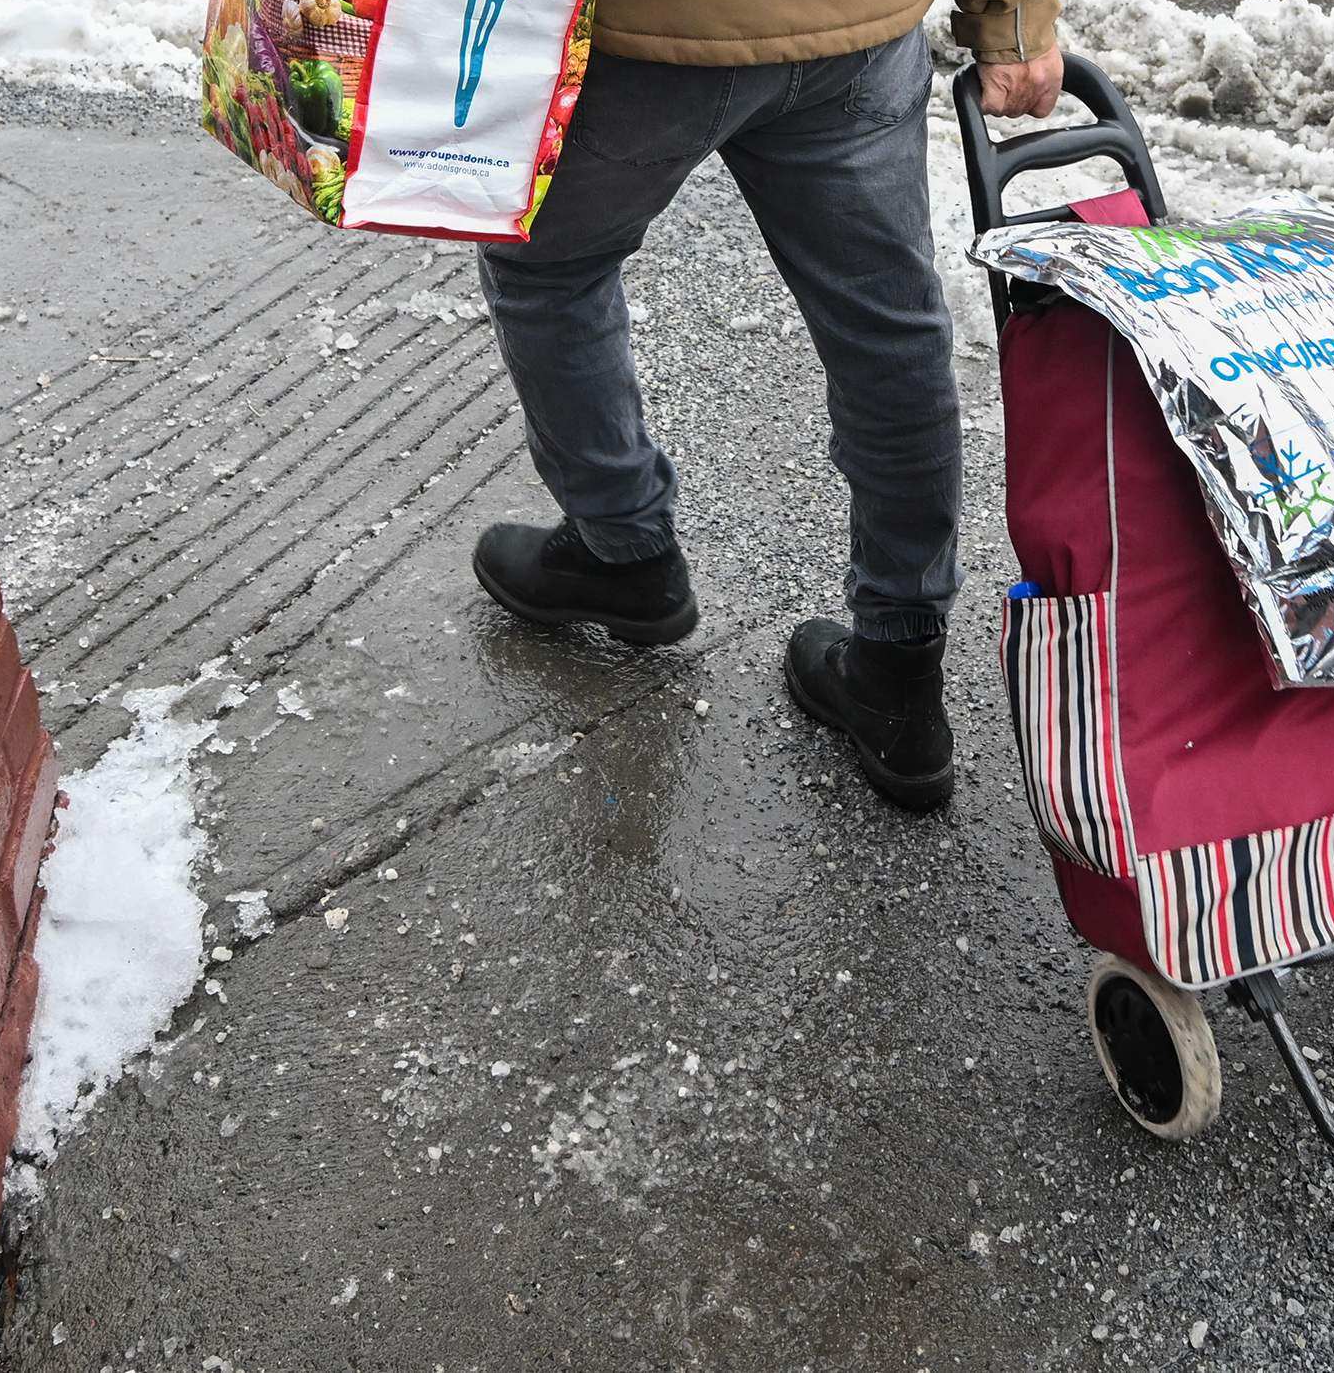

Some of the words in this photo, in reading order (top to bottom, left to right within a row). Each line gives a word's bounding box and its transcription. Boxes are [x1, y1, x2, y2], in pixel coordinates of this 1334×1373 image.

[388, 147, 510, 168] www.groupeadonis.ca
[403, 160, 490, 178] www.adonisgroup.ca
[1105, 258, 1236, 302] Bon
